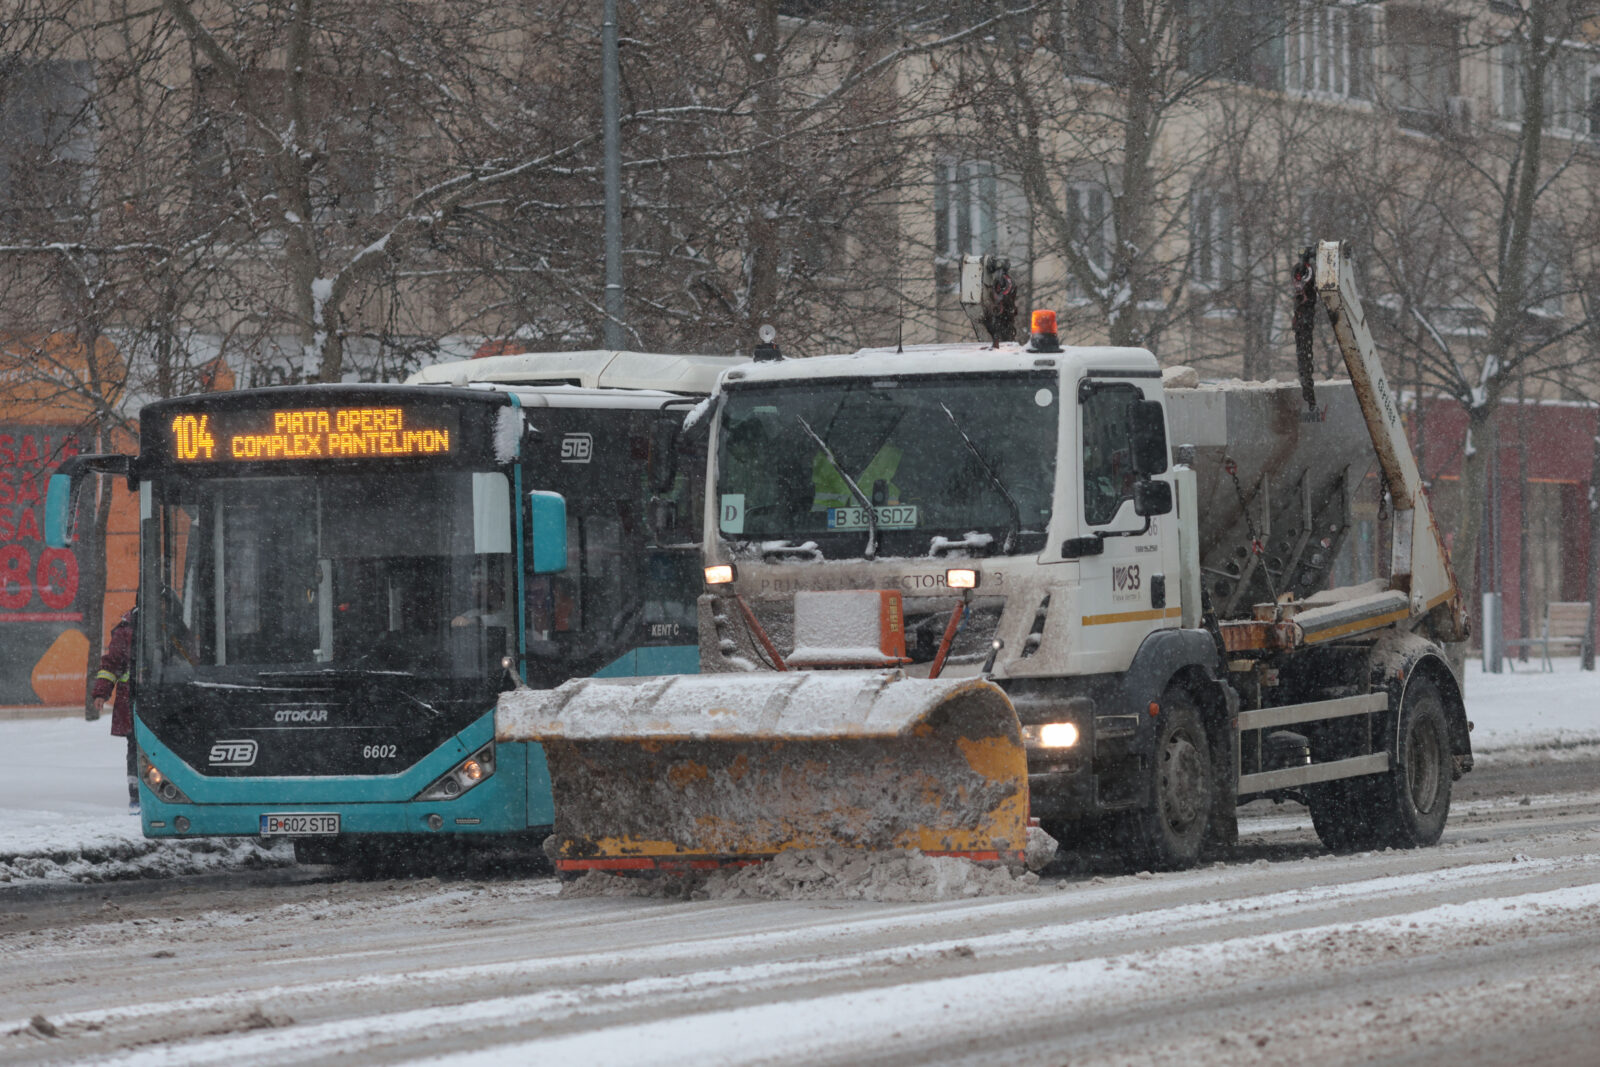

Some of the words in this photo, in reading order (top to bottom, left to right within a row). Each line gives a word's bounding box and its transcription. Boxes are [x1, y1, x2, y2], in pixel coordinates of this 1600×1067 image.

[273, 410, 330, 434] PIATA
[336, 408, 403, 431] OPEREI
[171, 414, 214, 459] 104
[231, 433, 322, 457] COMPLEX
[327, 429, 449, 455] PANTELIMON
[0, 434, 80, 469] SALE
[560, 437, 591, 459] STB
[724, 504, 738, 522] D
[836, 509, 848, 526] B
[881, 507, 915, 524] SDZ
[0, 543, 80, 610] 80
[993, 572, 1004, 586] 3
[651, 625, 672, 637] KENT
[673, 623, 680, 636] C
[274, 710, 328, 723] OTOKAR
[208, 743, 256, 764] STB
[363, 744, 397, 759] 6602
[269, 816, 280, 833] B
[283, 816, 308, 833] 602
[309, 816, 337, 832] STB
